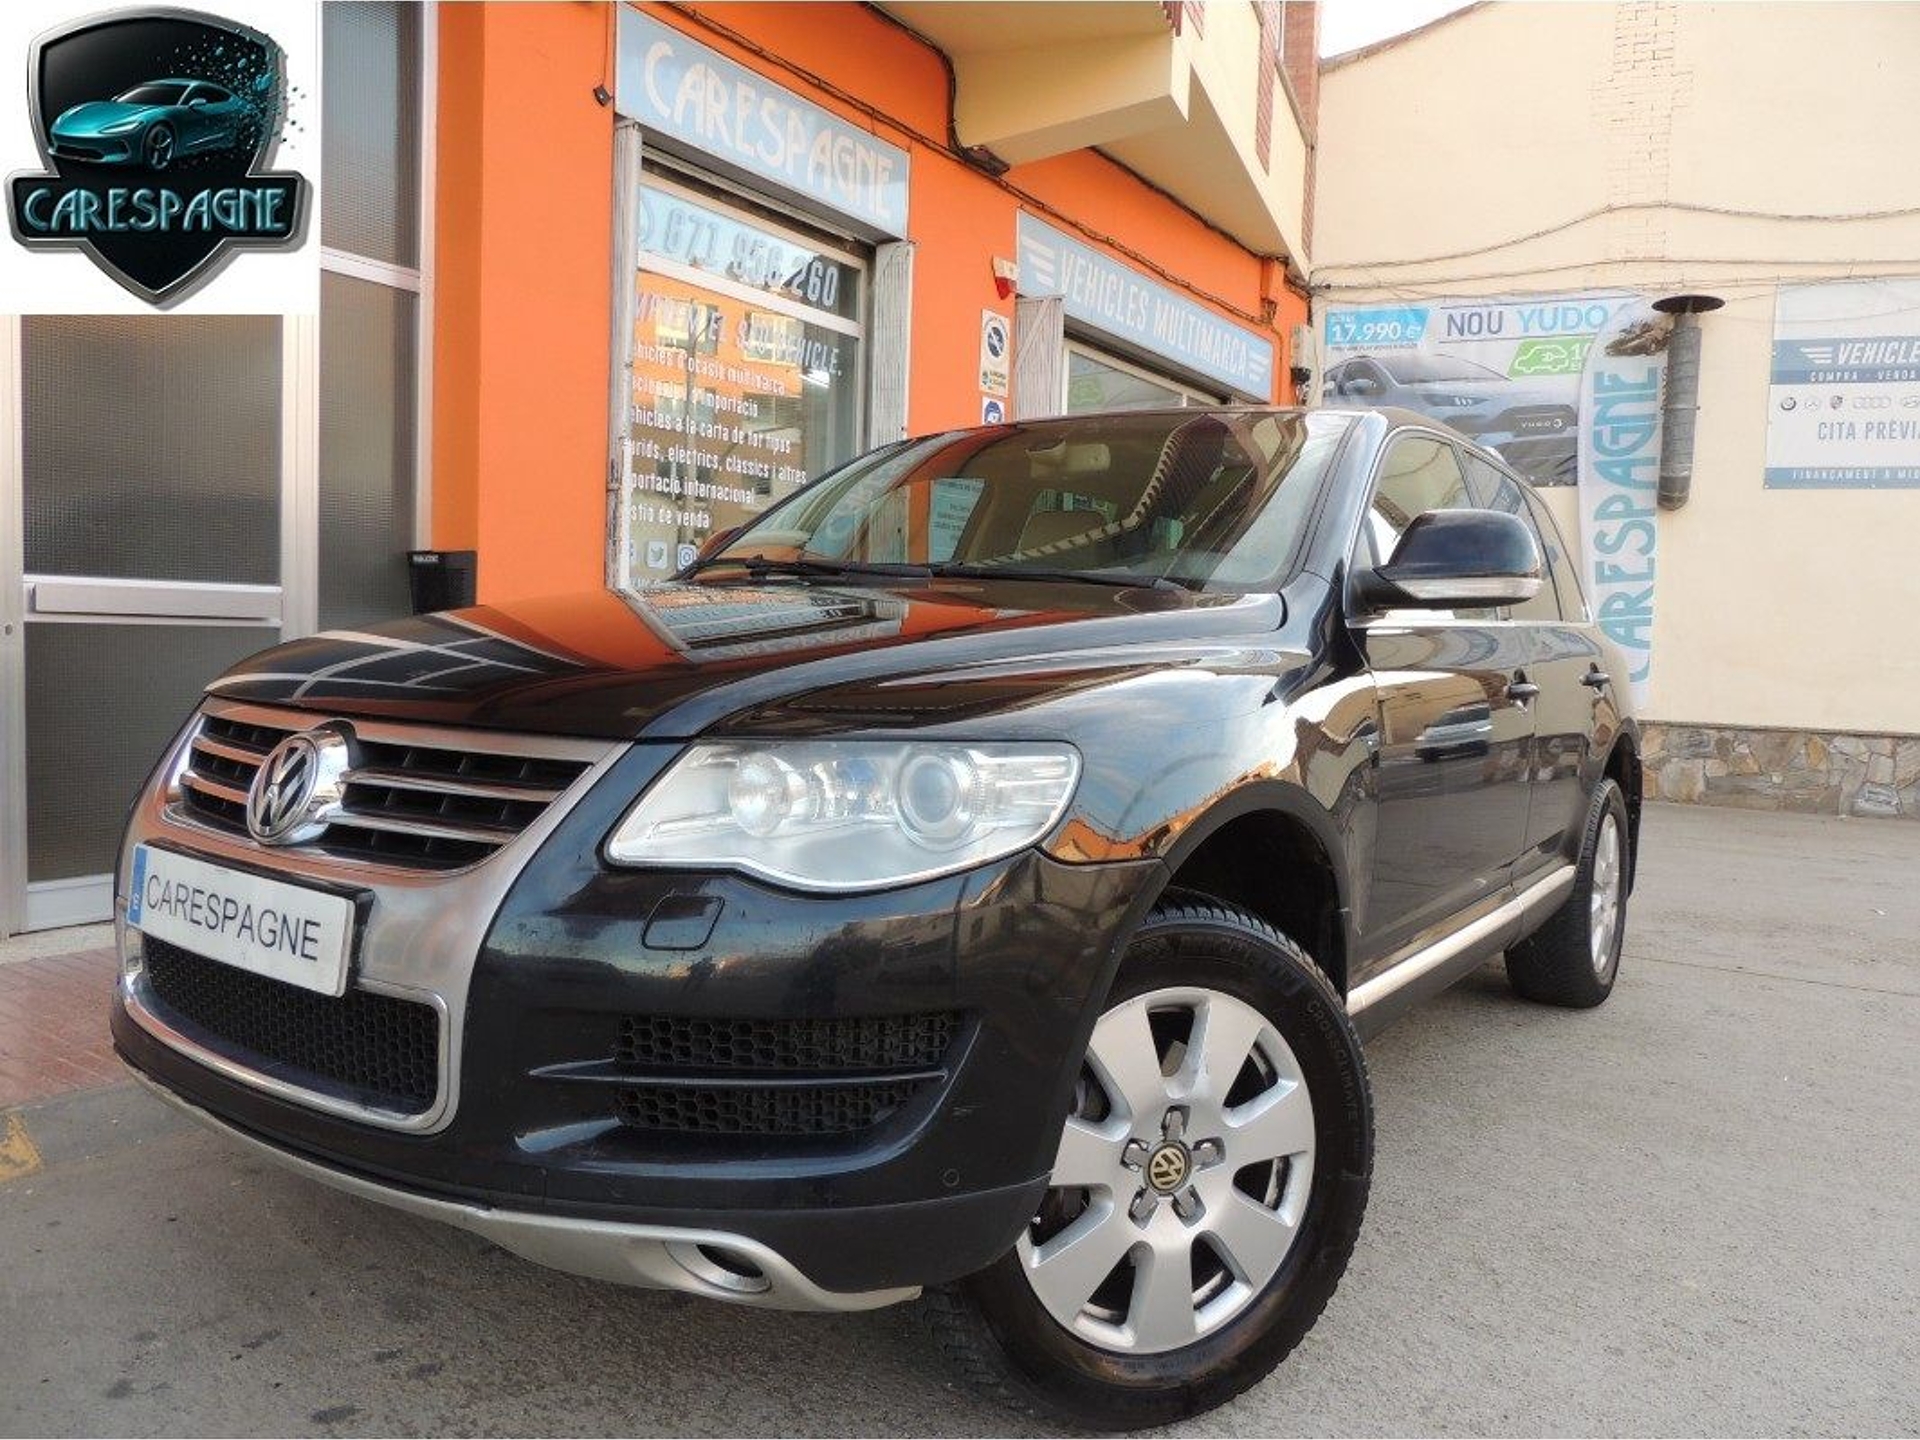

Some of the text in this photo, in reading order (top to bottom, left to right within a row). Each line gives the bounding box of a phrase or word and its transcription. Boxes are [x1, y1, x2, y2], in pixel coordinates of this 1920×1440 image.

[645, 41, 894, 219] CARESPAGNE
[790, 256, 839, 306] 260
[1060, 247, 1250, 379] VEHICLES MULTIMARCA
[1331, 322, 1401, 341] 17.990
[1447, 305, 1609, 337] NOU YUDO
[1818, 422, 1857, 441] CITA
[146, 874, 322, 962] CARESPAGNE
